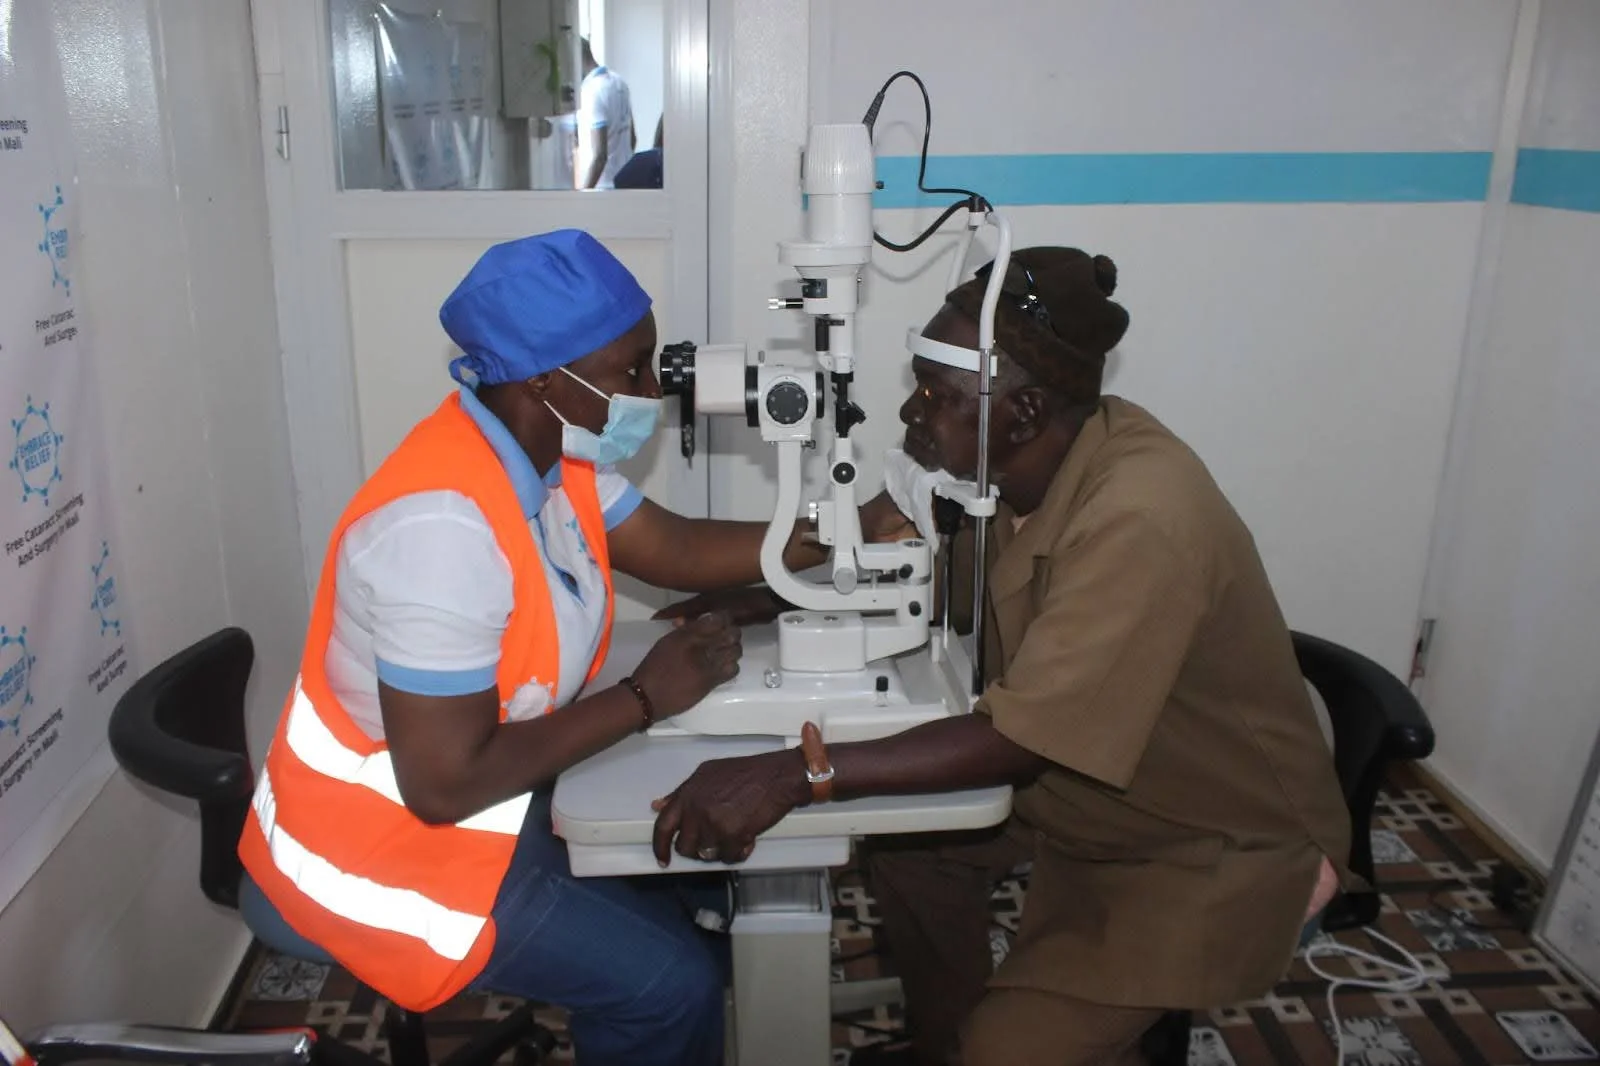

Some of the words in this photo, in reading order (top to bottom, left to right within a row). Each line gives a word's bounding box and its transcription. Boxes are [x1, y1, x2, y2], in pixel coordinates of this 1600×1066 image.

[35, 319, 50, 333] Free
[17, 431, 51, 459] EMBRACE
[25, 447, 50, 472] RELIEF
[6, 537, 24, 556] Free
[25, 514, 56, 542] Cataract
[18, 547, 34, 568] And
[65, 511, 79, 529] Mali
[27, 707, 63, 748] Screening
[4, 756, 33, 793] Surgery
[42, 728, 59, 750] Mali
